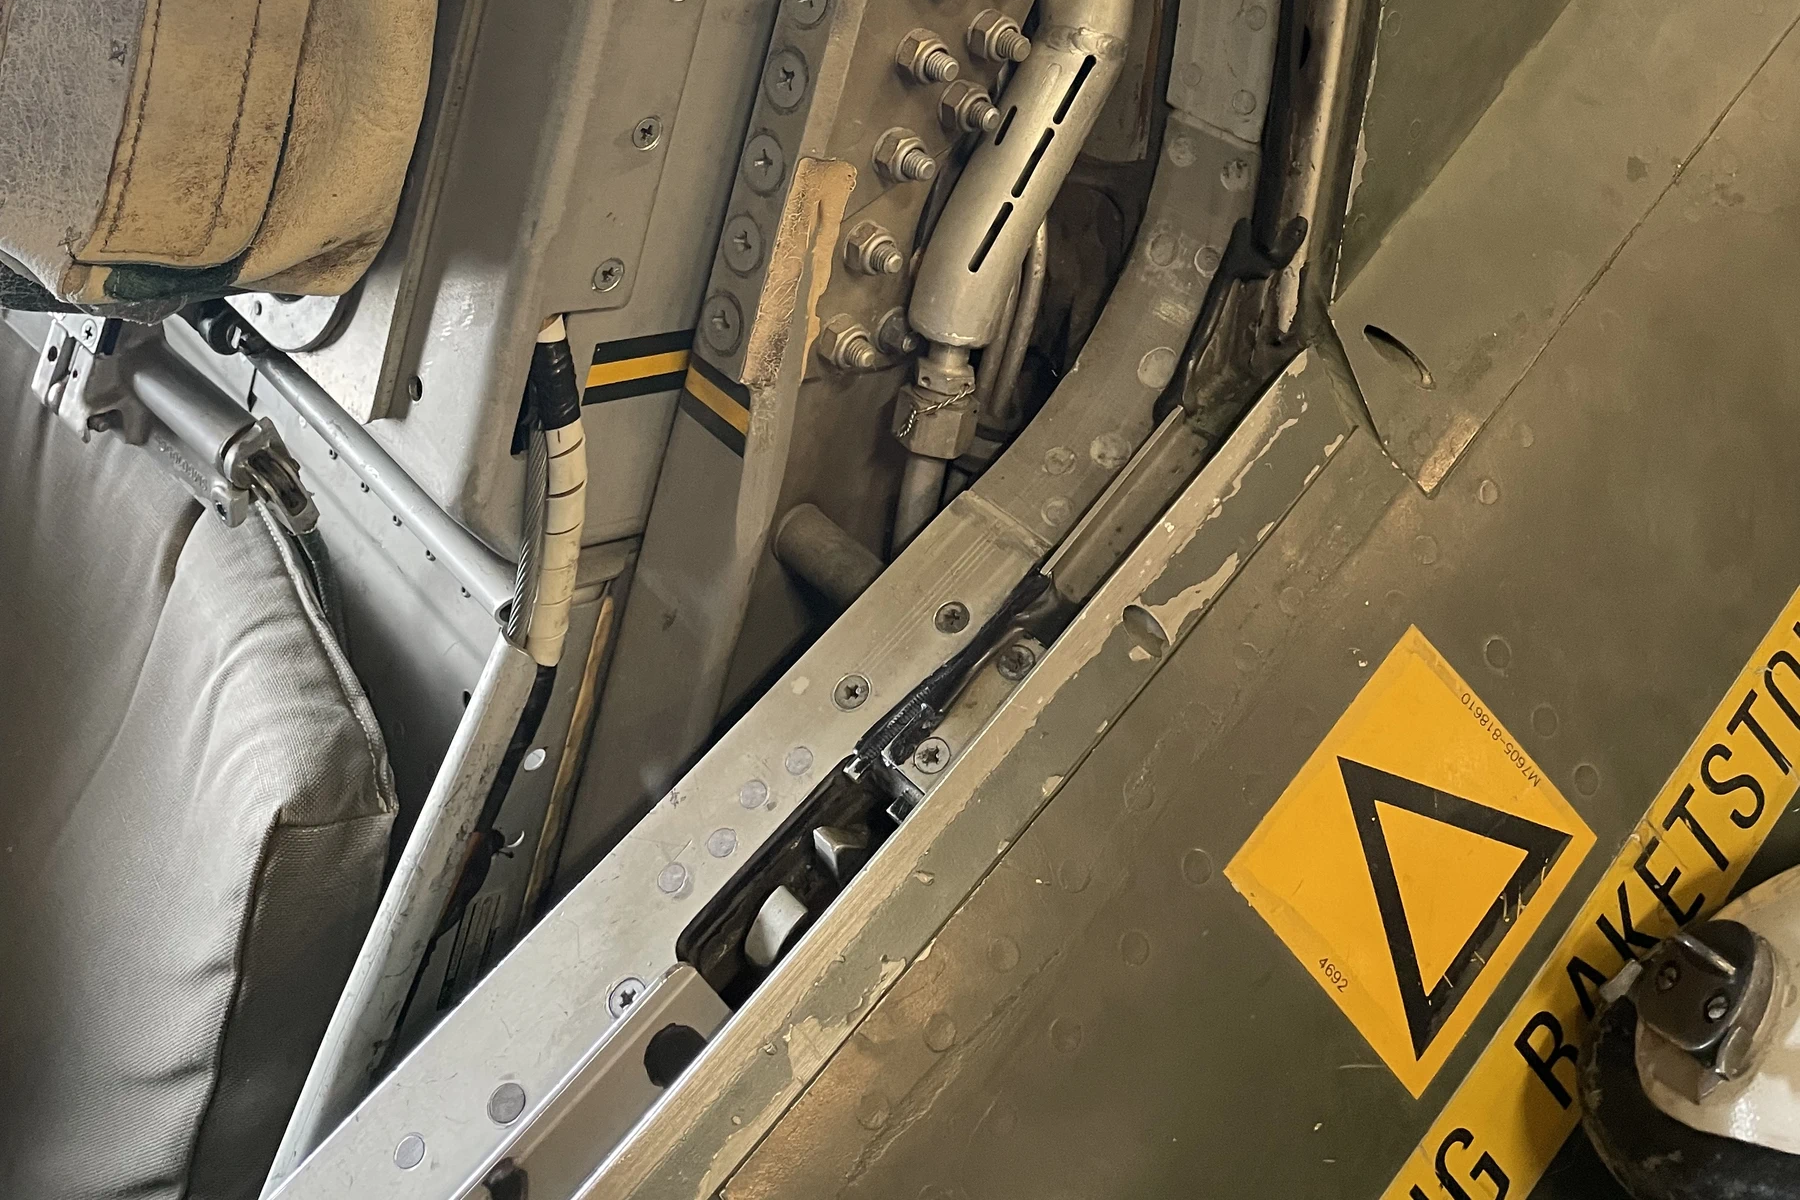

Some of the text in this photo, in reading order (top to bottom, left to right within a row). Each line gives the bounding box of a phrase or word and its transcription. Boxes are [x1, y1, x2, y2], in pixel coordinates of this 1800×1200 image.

[1461, 693, 1542, 788] M7605-818610
[1513, 620, 1800, 1110] RAKETSTO
[1319, 957, 1348, 994] 4692
[1408, 1127, 1510, 1200] G
